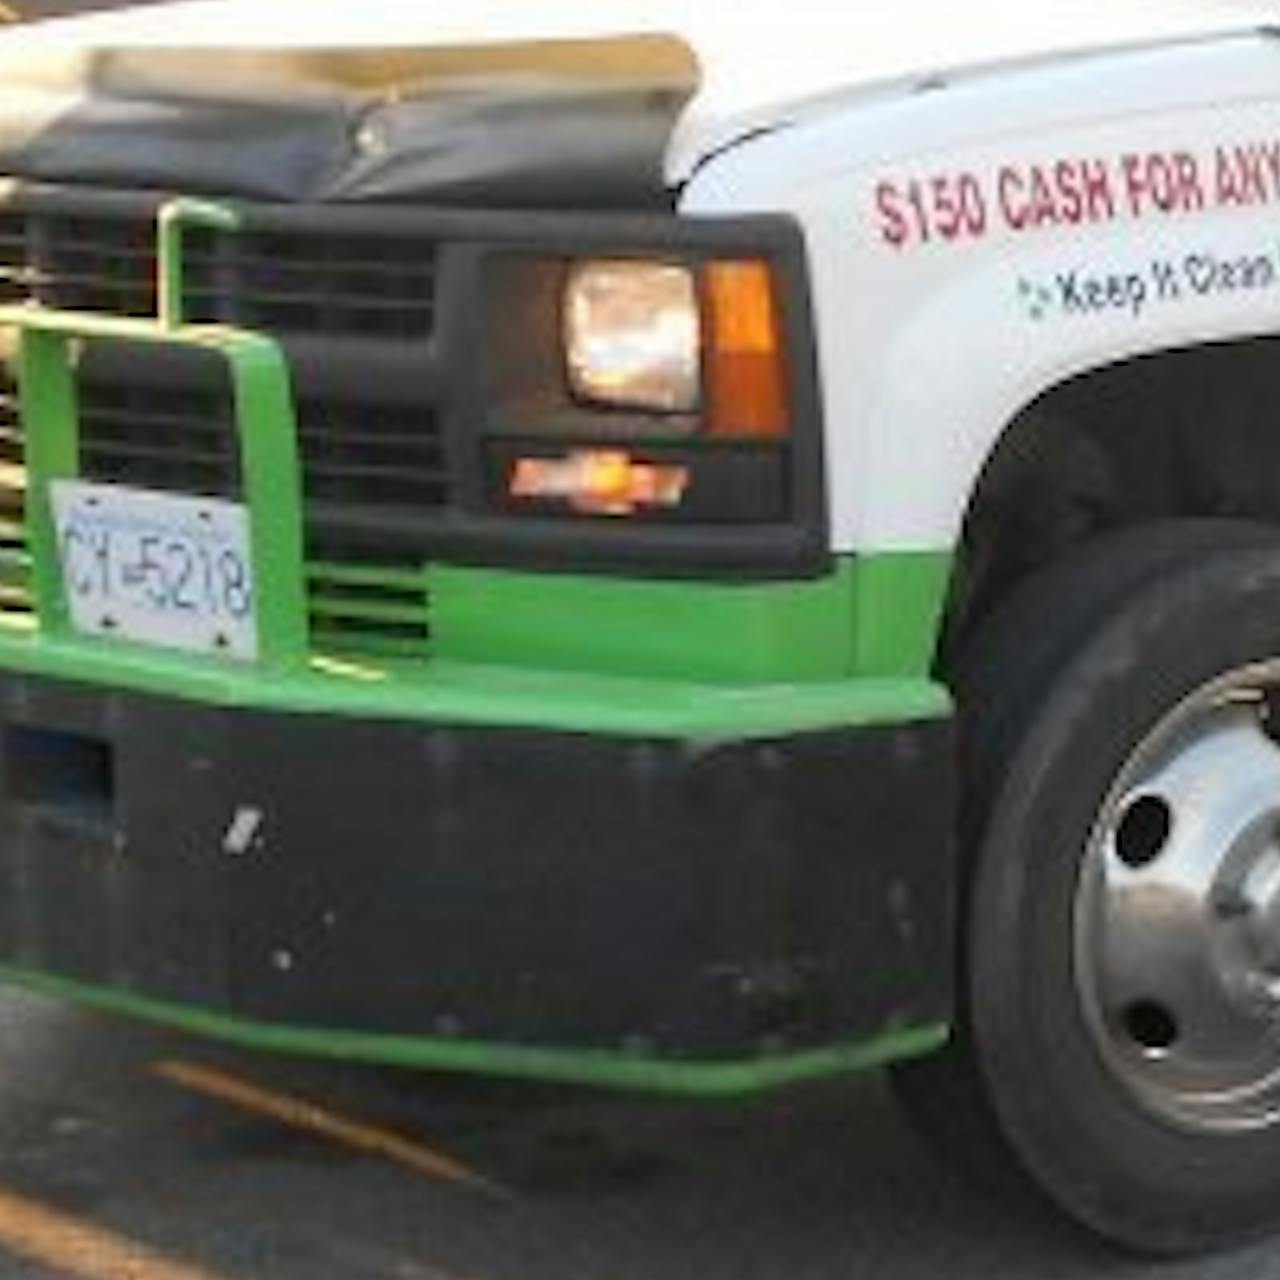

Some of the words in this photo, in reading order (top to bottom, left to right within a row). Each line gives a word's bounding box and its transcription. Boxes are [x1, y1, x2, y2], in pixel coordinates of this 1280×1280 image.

[998, 158, 1116, 231] CASH
[1120, 149, 1203, 220] FOR
[1055, 272, 1147, 318] Keep
[1184, 251, 1275, 297] Clean
